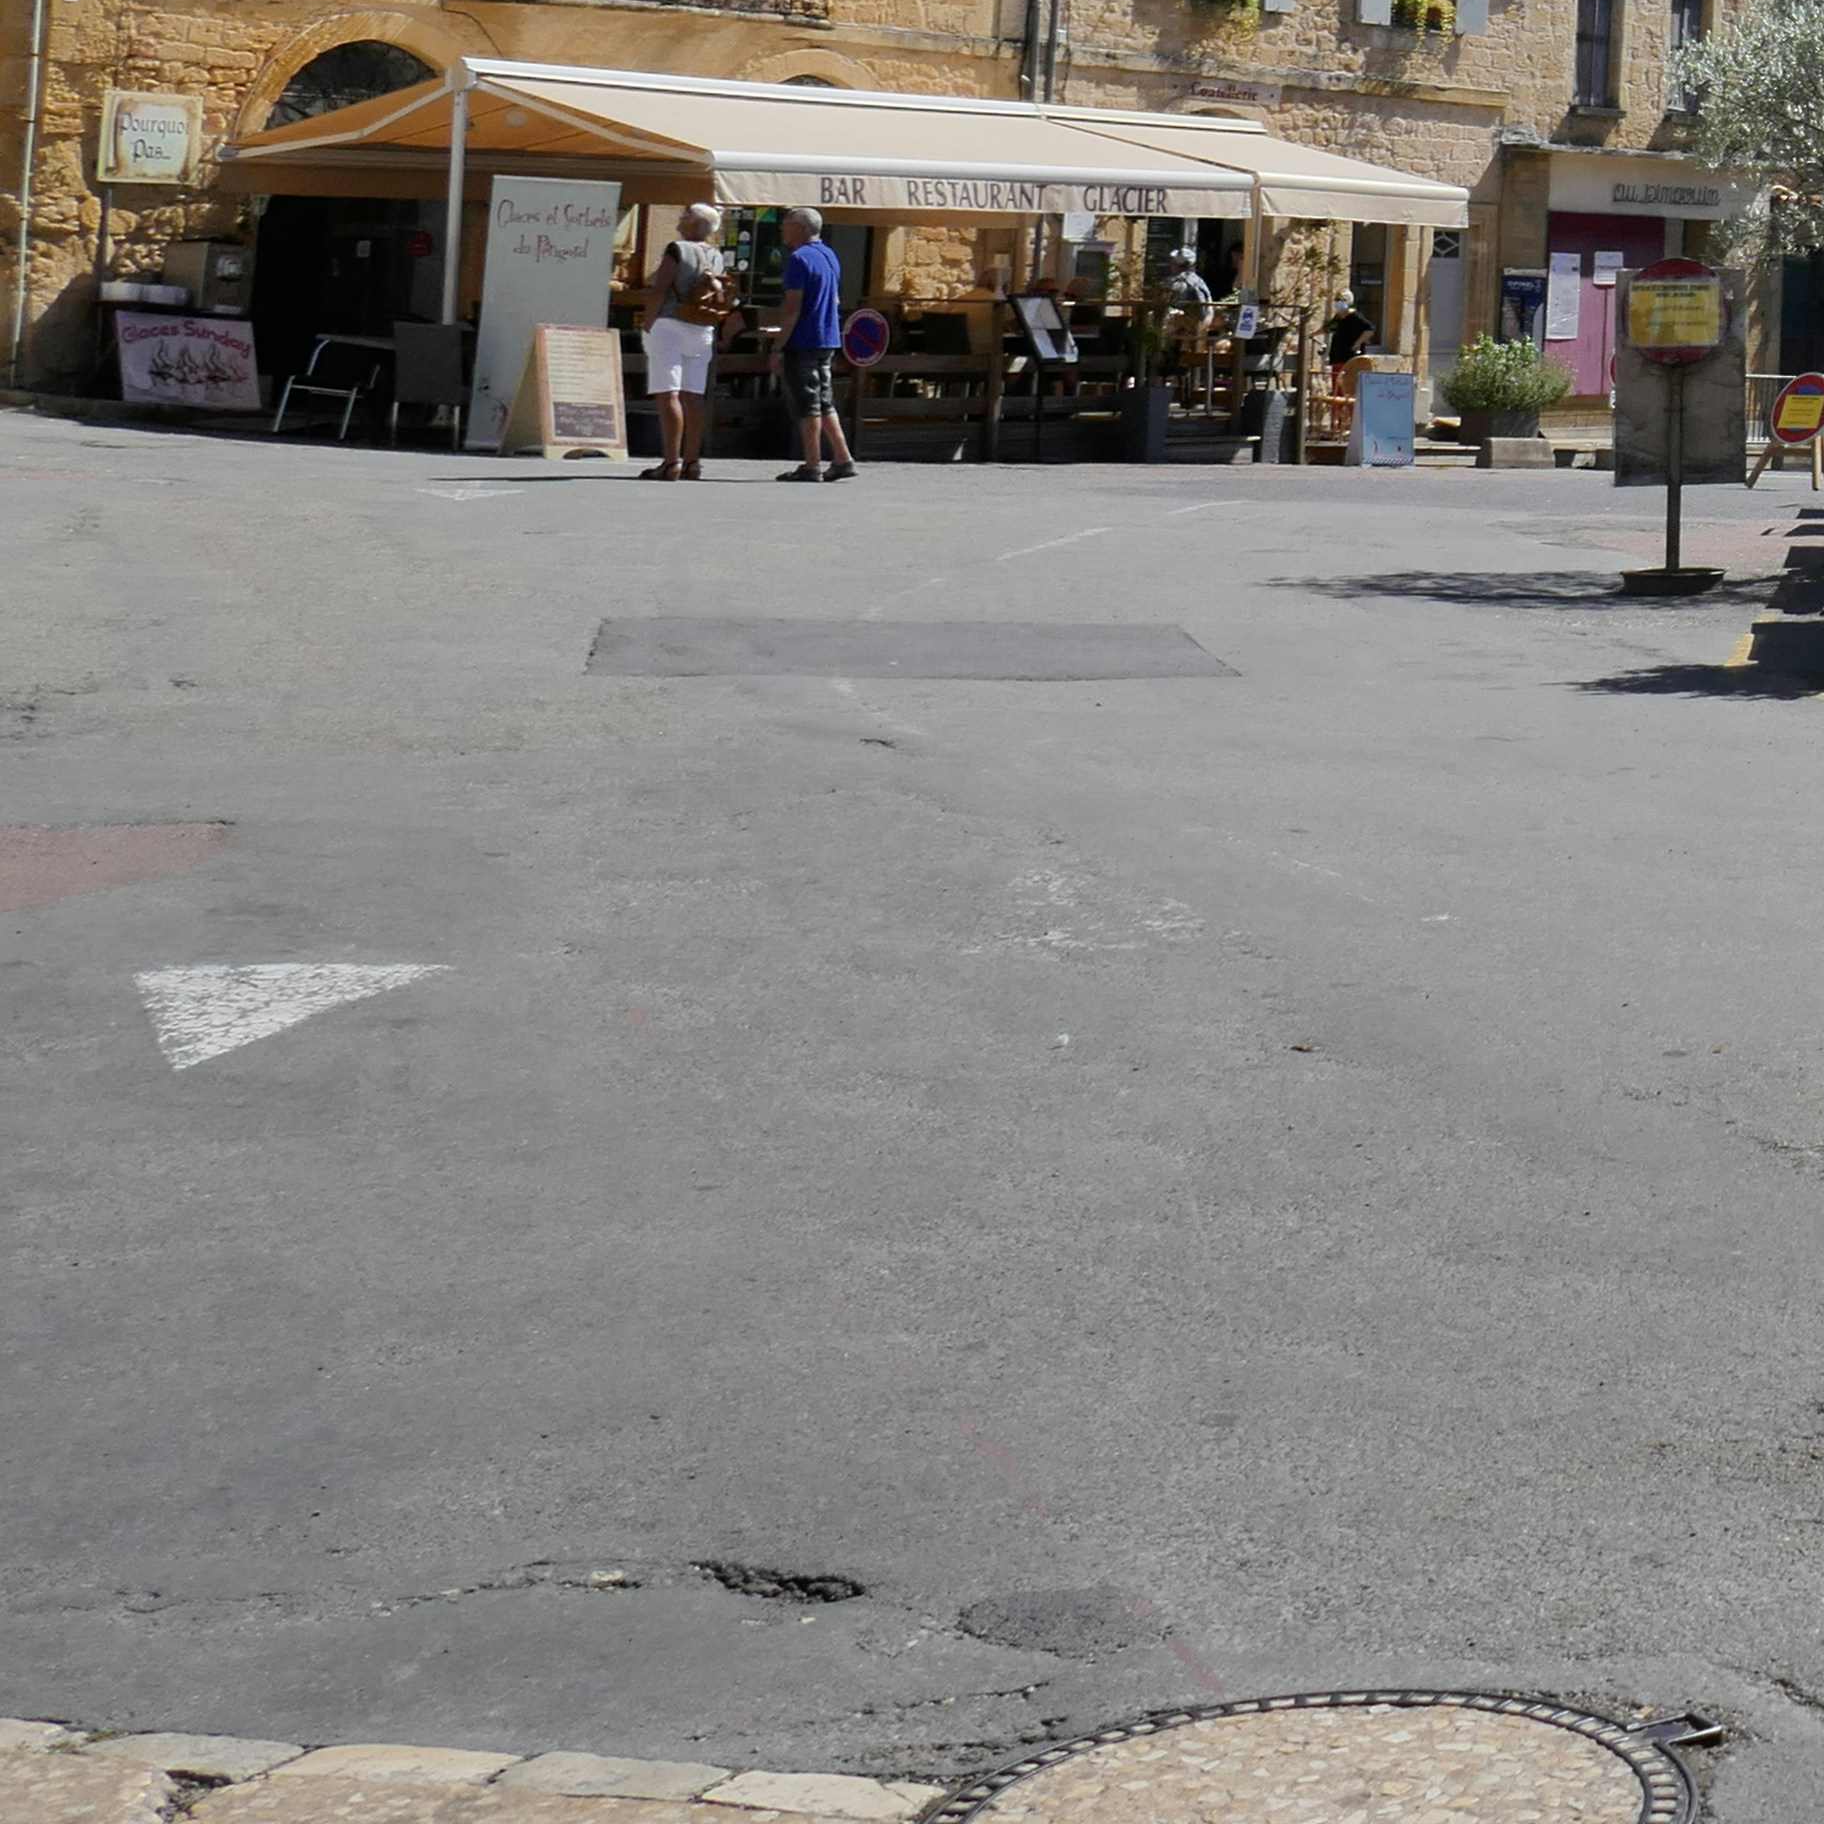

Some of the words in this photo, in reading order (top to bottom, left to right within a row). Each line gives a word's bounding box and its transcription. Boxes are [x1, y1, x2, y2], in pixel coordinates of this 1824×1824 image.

[1191, 81, 1259, 102] Coutellerie
[119, 112, 190, 139] Pourquoi
[820, 177, 866, 205] BAR
[906, 180, 1044, 210] RESTAURANT
[1083, 185, 1168, 214] GLACIER
[497, 199, 541, 228] Glaces
[546, 205, 559, 226] et
[122, 326, 180, 344] Glaces
[183, 320, 252, 359] Sunday
